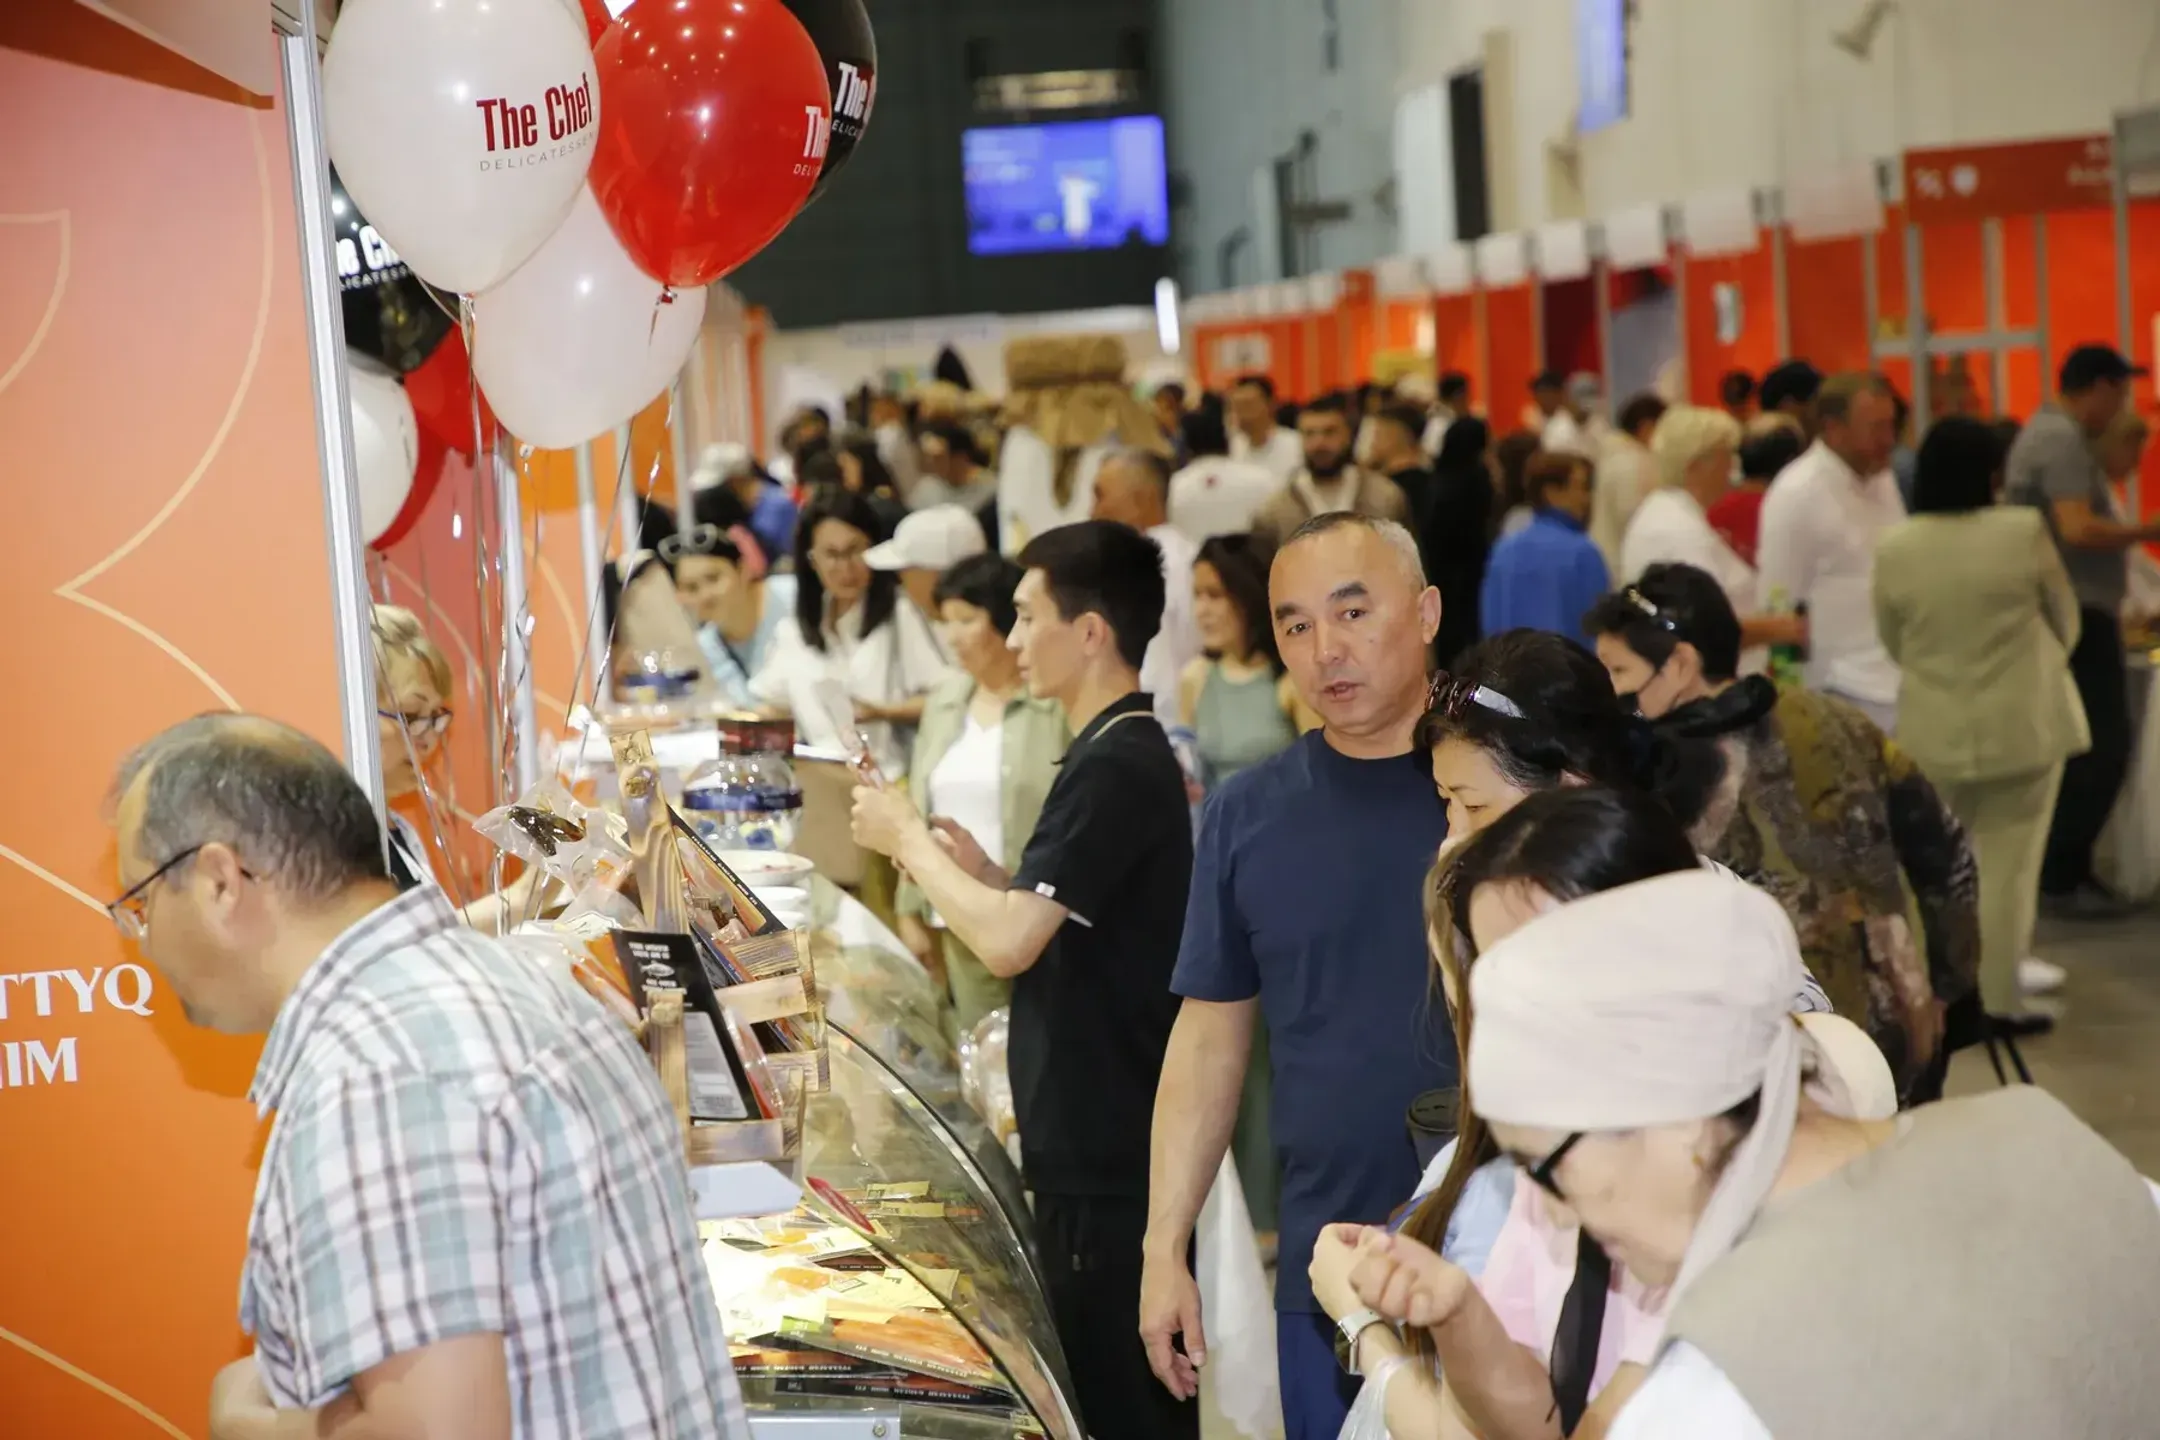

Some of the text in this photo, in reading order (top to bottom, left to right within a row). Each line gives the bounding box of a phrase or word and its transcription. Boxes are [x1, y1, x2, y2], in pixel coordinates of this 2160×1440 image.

[476, 71, 592, 151] The Chef
[0, 1037, 78, 1089] IM
